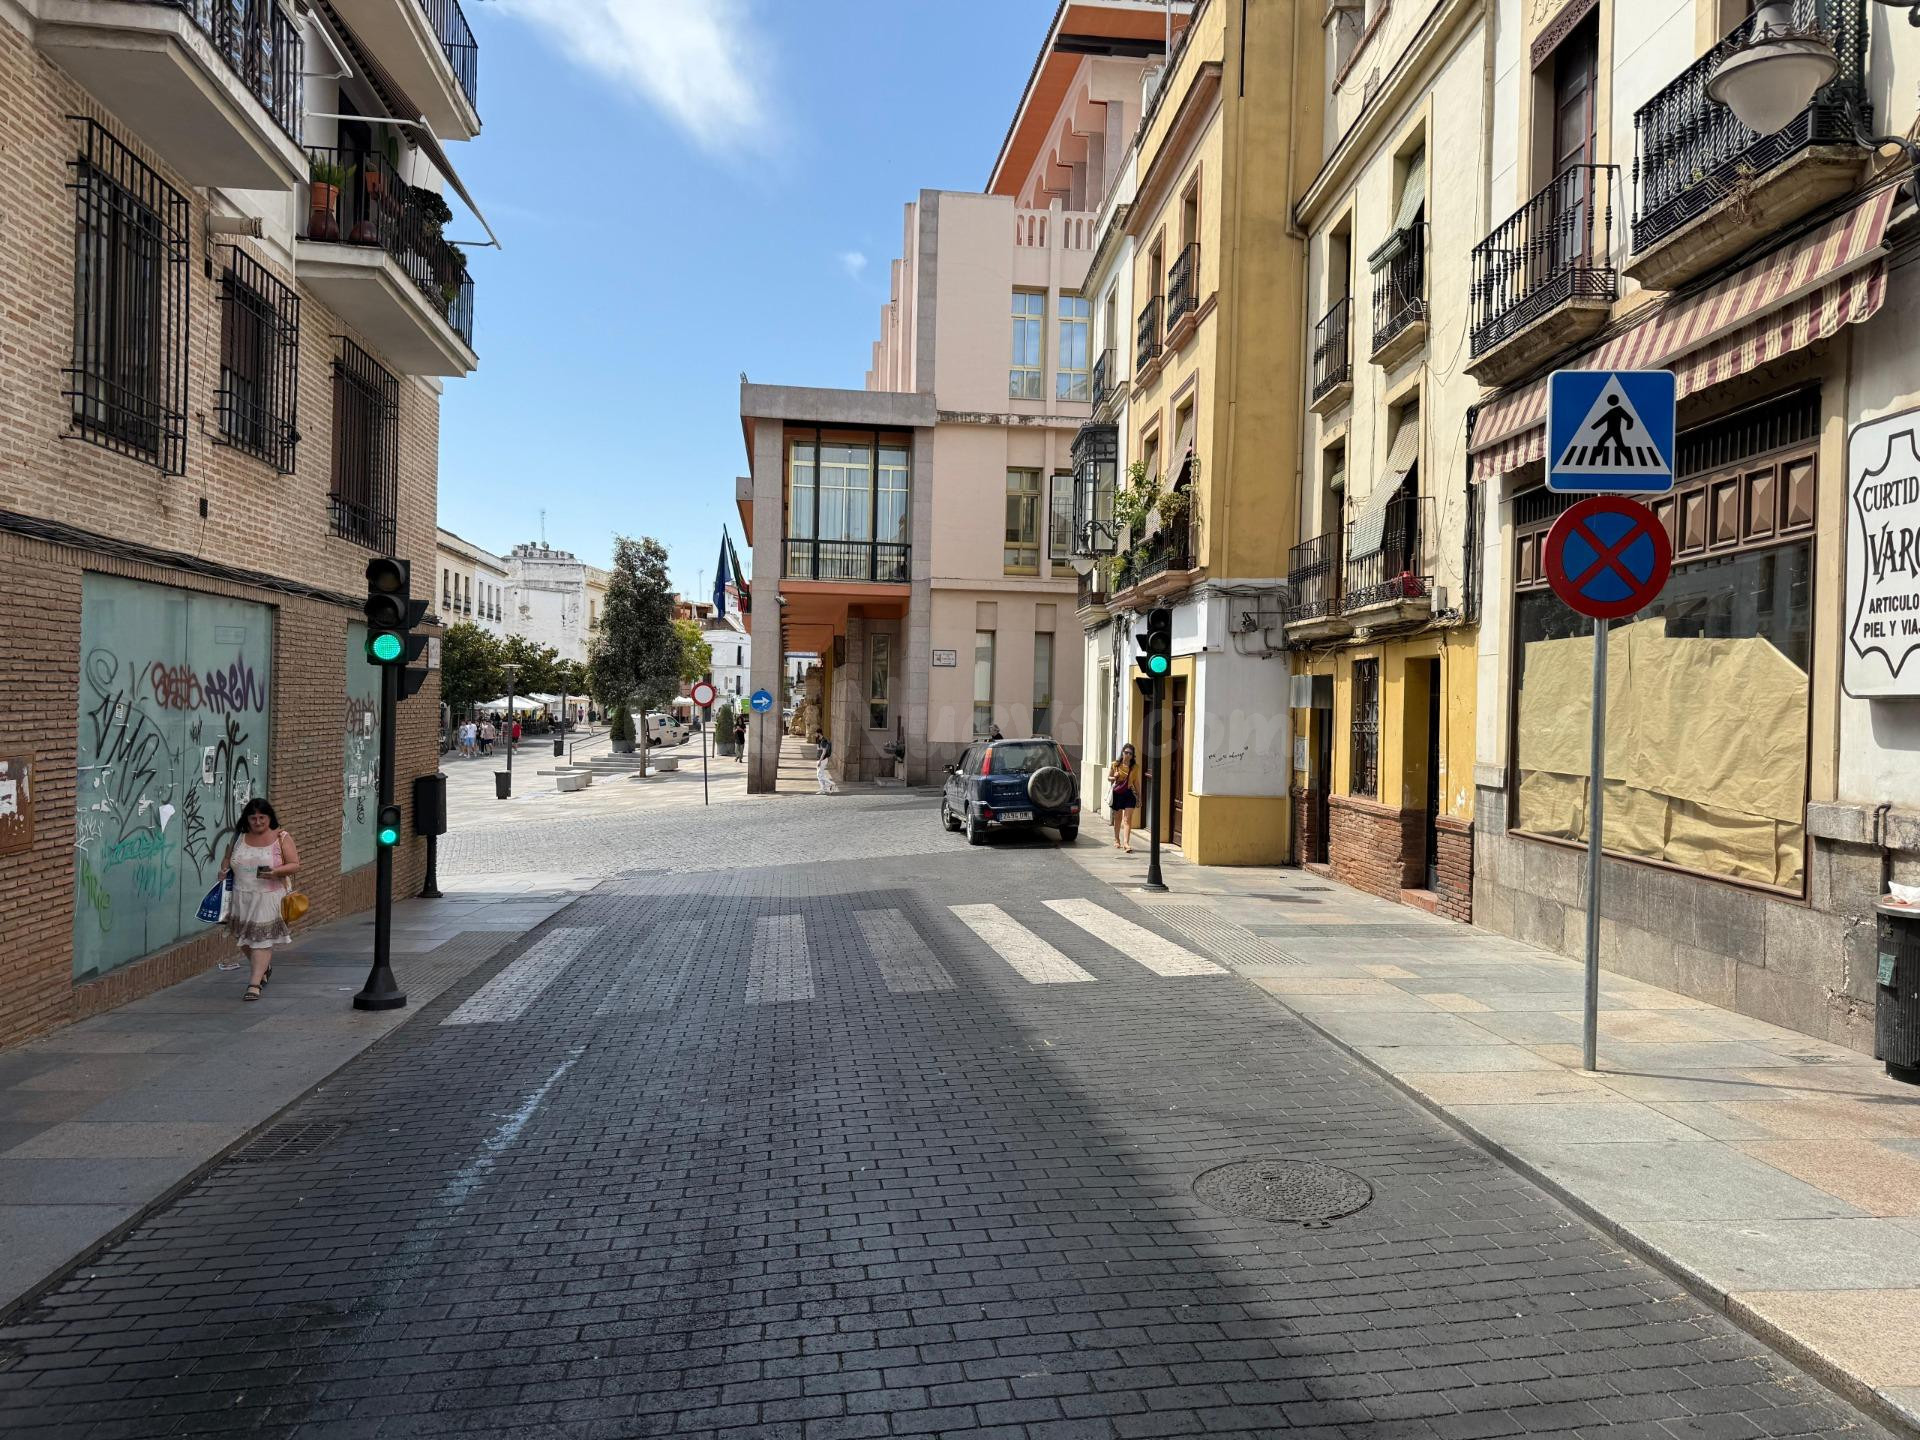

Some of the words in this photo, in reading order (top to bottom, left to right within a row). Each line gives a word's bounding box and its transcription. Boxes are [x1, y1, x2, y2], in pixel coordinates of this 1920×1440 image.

[1863, 475, 1919, 512] CURTID
[1869, 593, 1919, 615] ARTICULO
[1864, 621, 1886, 638] PIEL
[1889, 620, 1897, 637] Y
[1901, 618, 1920, 636] VIA
